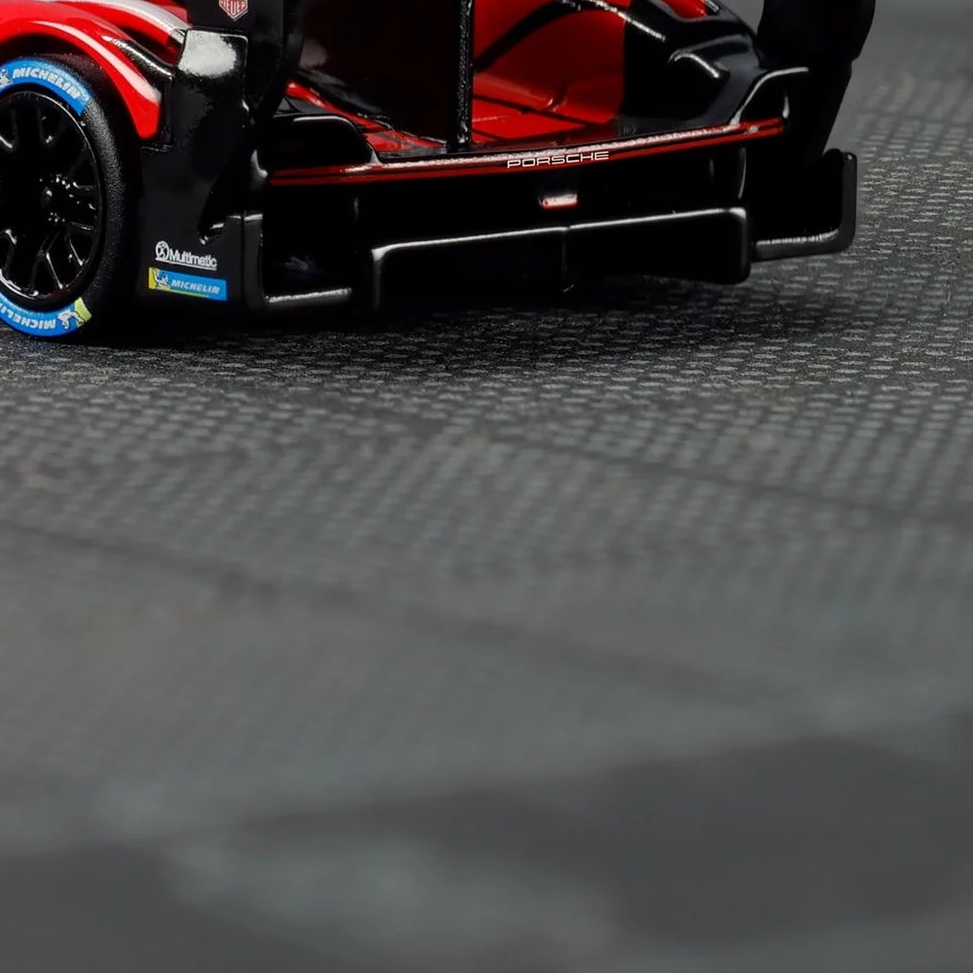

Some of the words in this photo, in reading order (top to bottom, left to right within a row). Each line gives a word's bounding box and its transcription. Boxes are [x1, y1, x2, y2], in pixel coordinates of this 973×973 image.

[12, 67, 80, 99] MICHELIN
[507, 151, 609, 169] PORSCHE
[169, 248, 217, 268] Multimatic
[171, 279, 220, 295] MICHELIN
